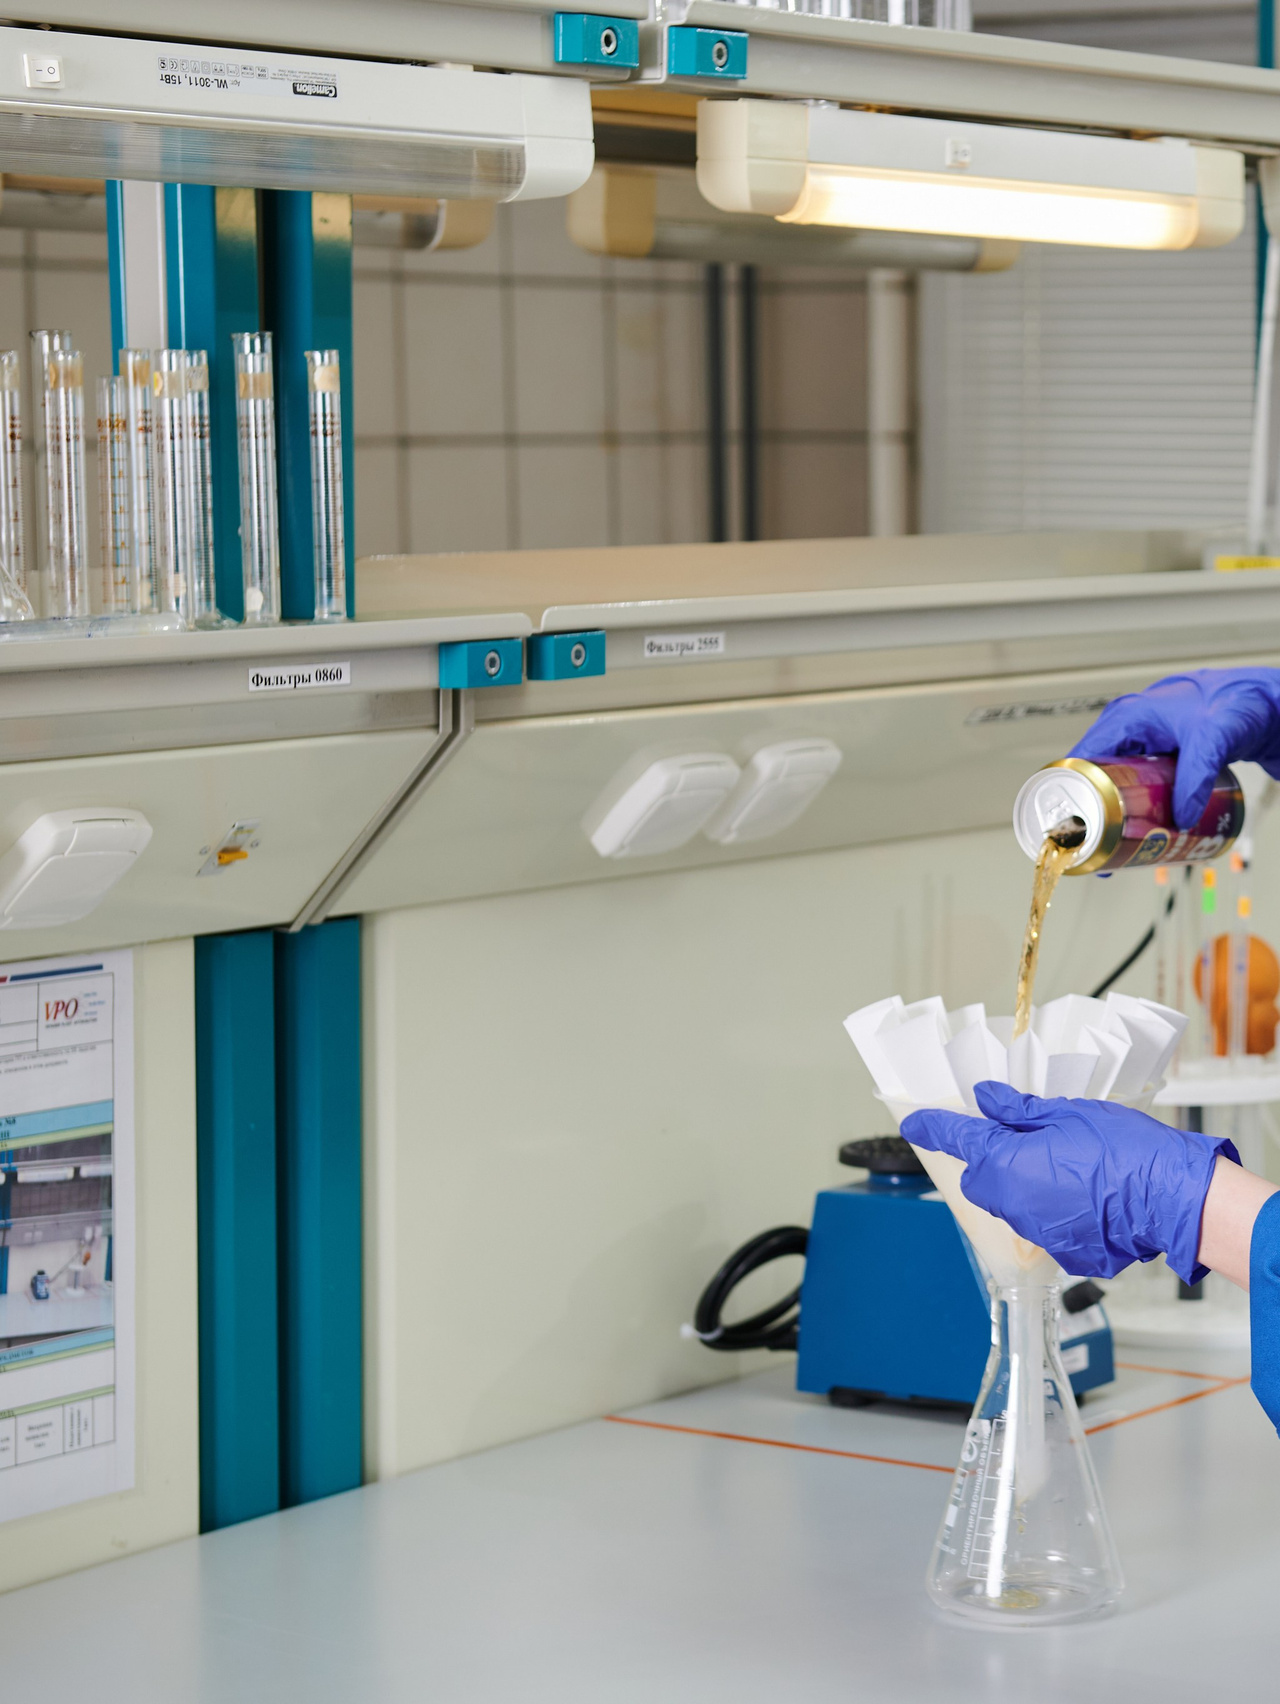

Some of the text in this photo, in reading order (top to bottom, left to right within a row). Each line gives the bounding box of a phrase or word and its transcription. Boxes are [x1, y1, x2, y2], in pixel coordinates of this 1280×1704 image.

[159, 73, 182, 84] 15Вт
[184, 75, 229, 89] WL-3011,
[646, 640, 695, 656] Фильтры
[251, 667, 343, 689] Фильтры 0860
[45, 998, 79, 1021] VPO
